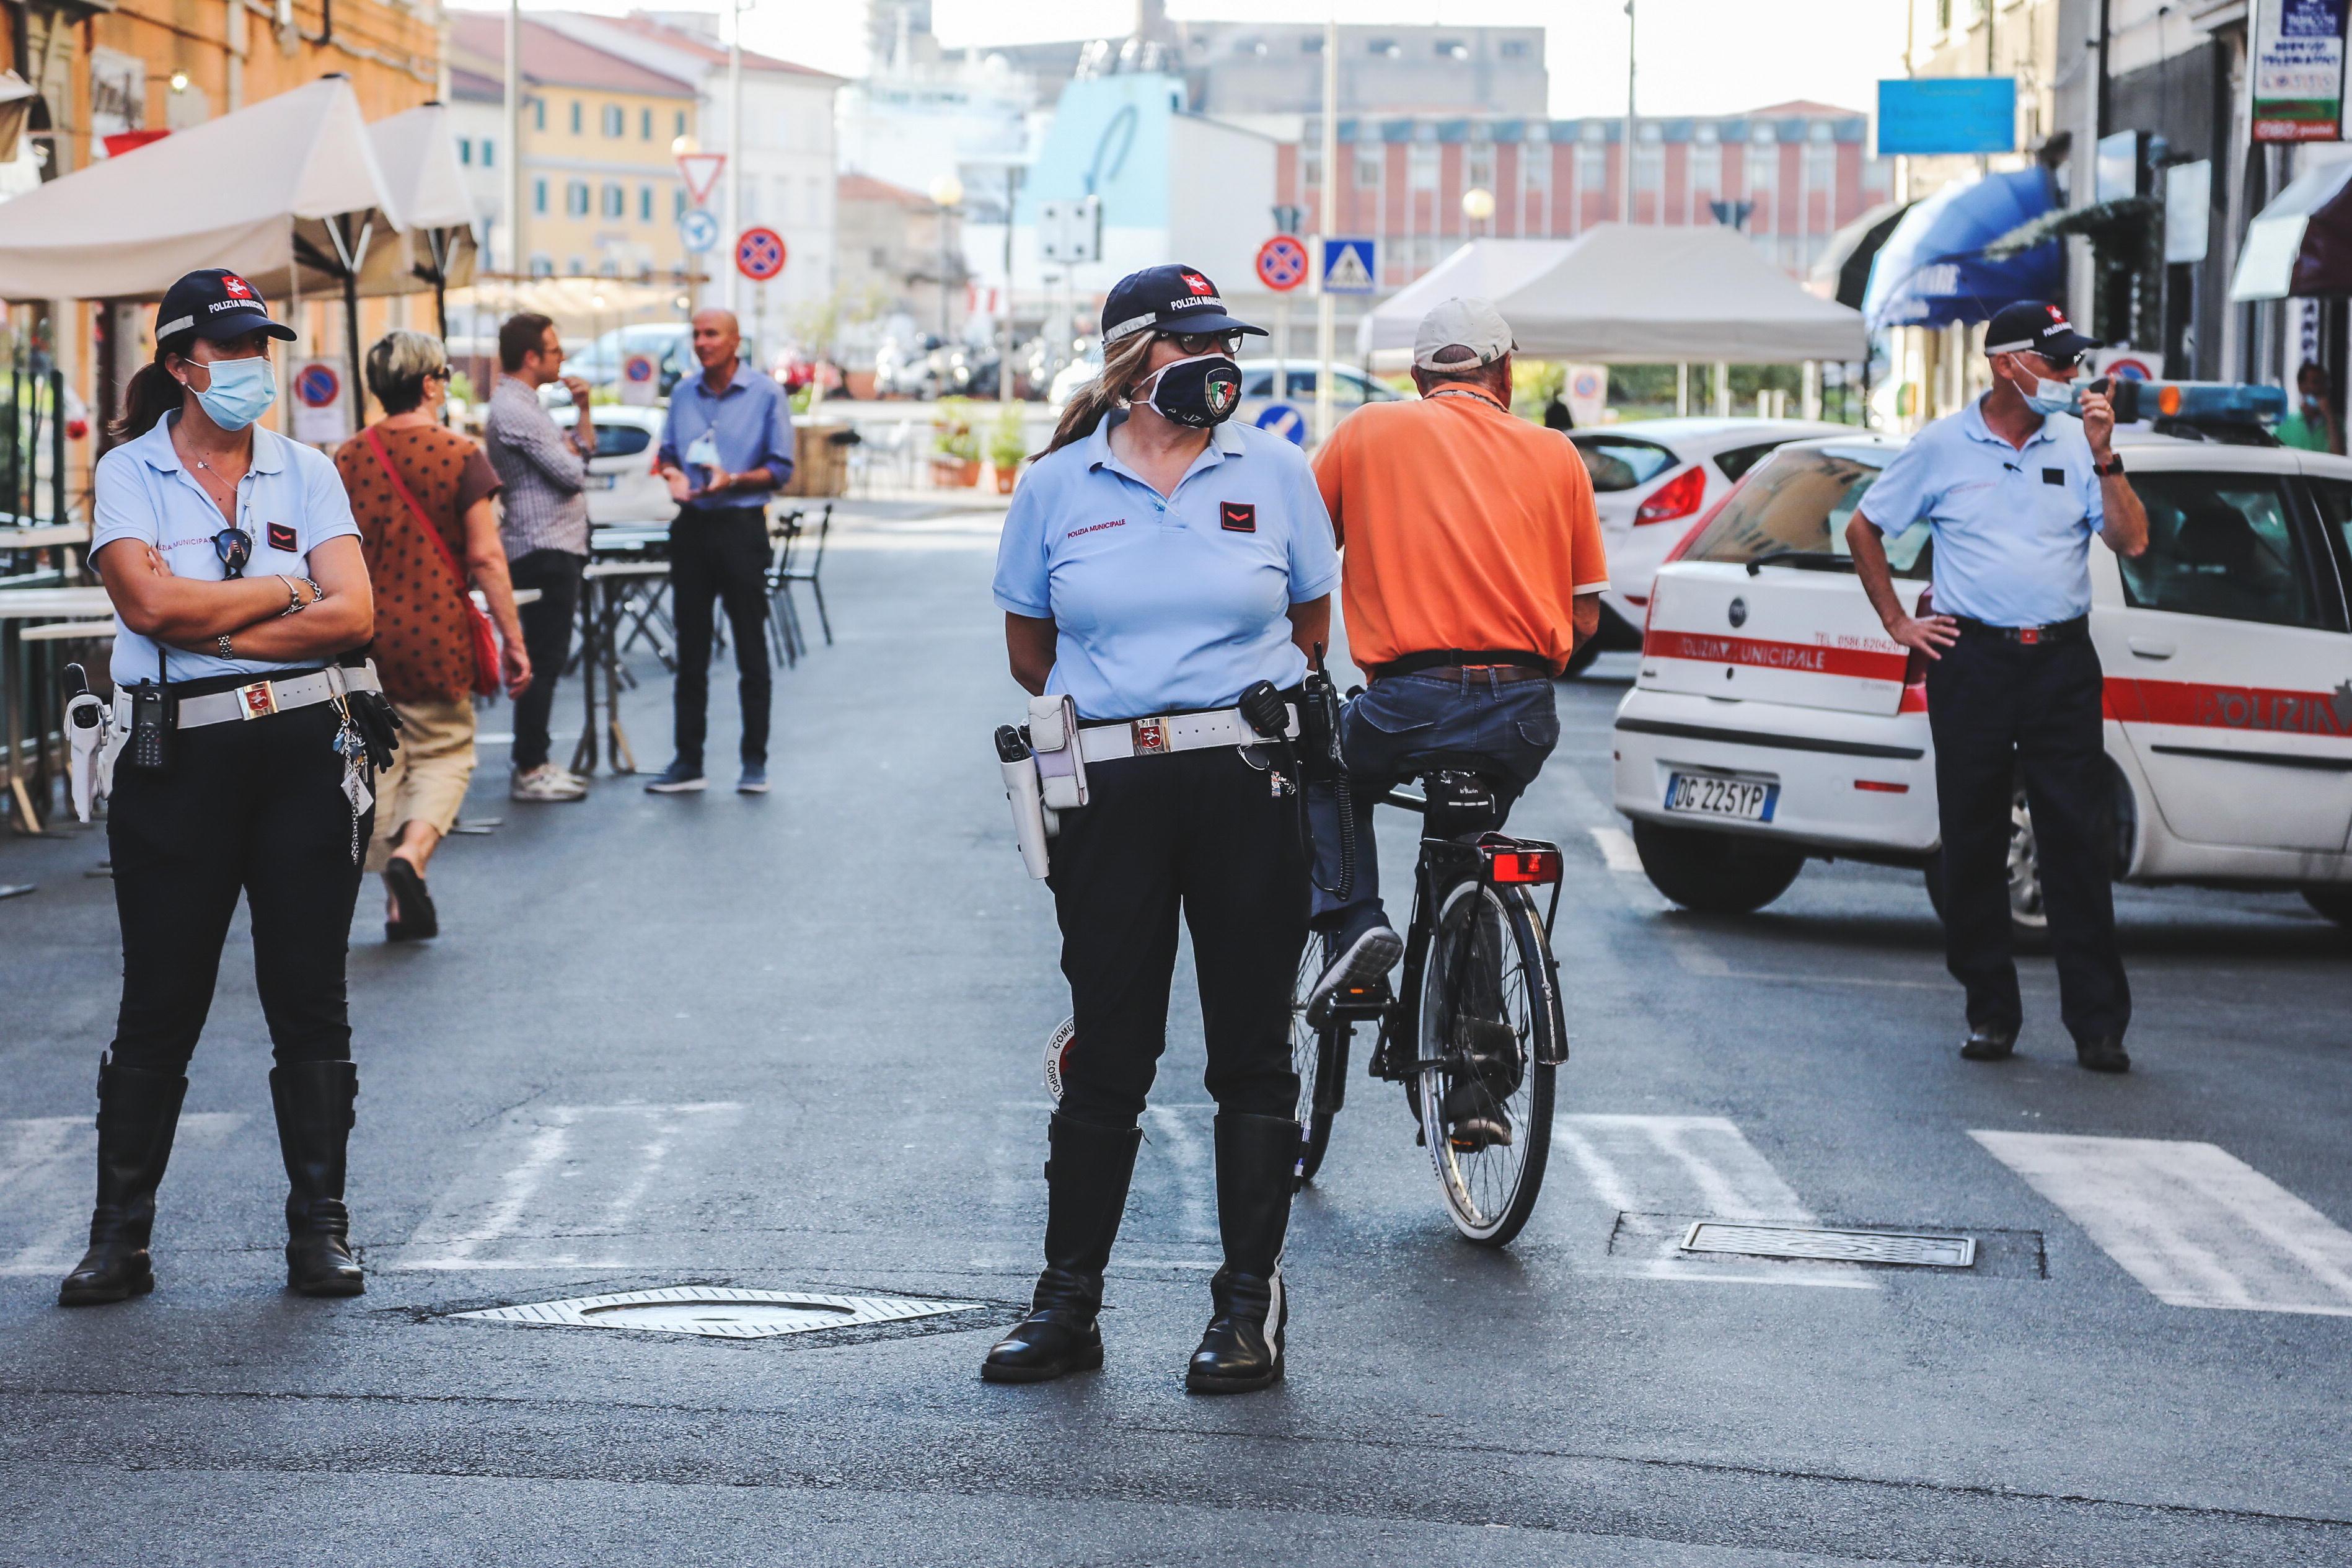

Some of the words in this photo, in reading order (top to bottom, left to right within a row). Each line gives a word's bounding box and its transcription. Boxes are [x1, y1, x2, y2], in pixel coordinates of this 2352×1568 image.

[208, 299, 240, 314] POLIZIA
[1170, 296, 1203, 311] POLIZIA
[1068, 527, 1089, 539] POLIZIA
[1090, 519, 1126, 532] MUNICIPALE
[1675, 777, 1698, 807] DG
[1701, 780, 1763, 814] 225YP
